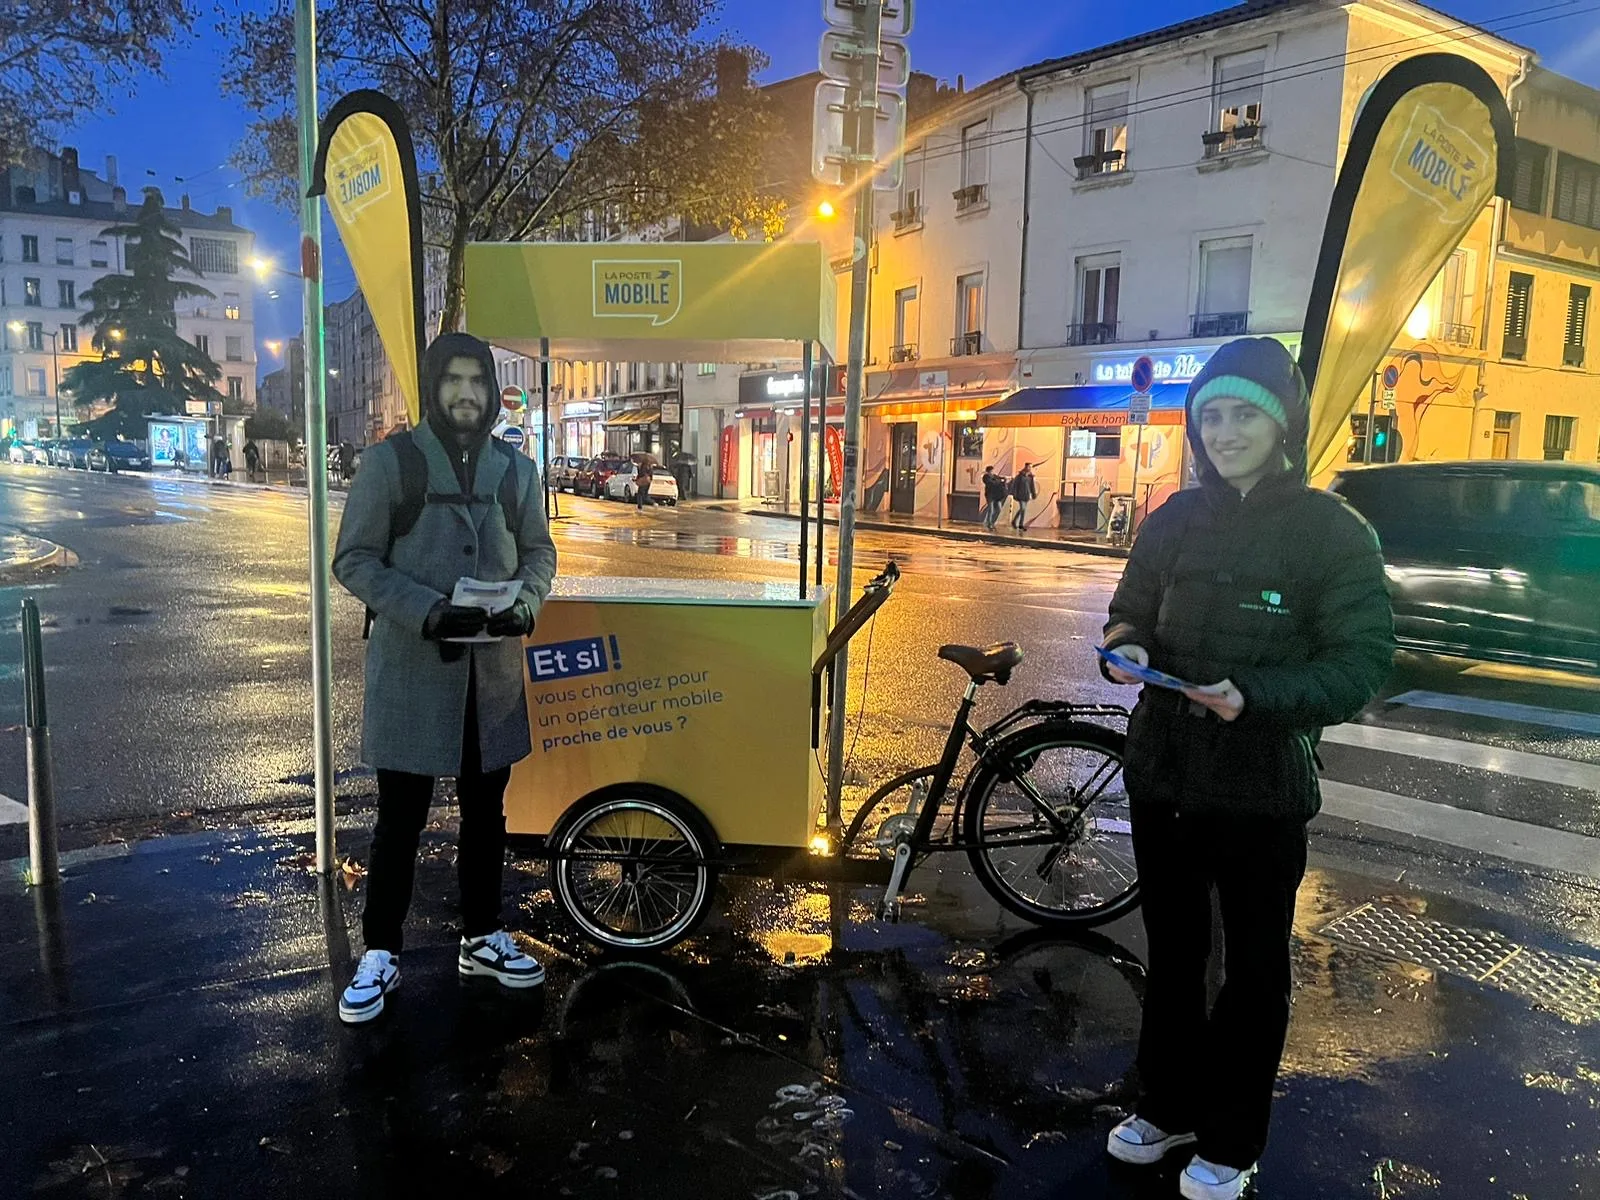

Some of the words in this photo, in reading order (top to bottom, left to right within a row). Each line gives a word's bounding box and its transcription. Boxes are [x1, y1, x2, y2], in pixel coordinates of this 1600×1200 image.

[1424, 124, 1437, 139] LA
[604, 272, 618, 280] LA
[620, 271, 652, 280] POSTE
[1101, 413, 1127, 425] hom
[533, 649, 569, 676] Et
[576, 643, 600, 670] si
[608, 634, 622, 670] !
[535, 687, 576, 705] vous
[582, 677, 661, 698] changiez
[668, 671, 709, 690] pour
[539, 714, 560, 728] un
[566, 700, 657, 725] opérateur
[663, 689, 723, 710] mobile
[542, 729, 602, 752] proche
[606, 725, 627, 740] de
[632, 720, 673, 736] vous
[677, 715, 688, 731] ?
